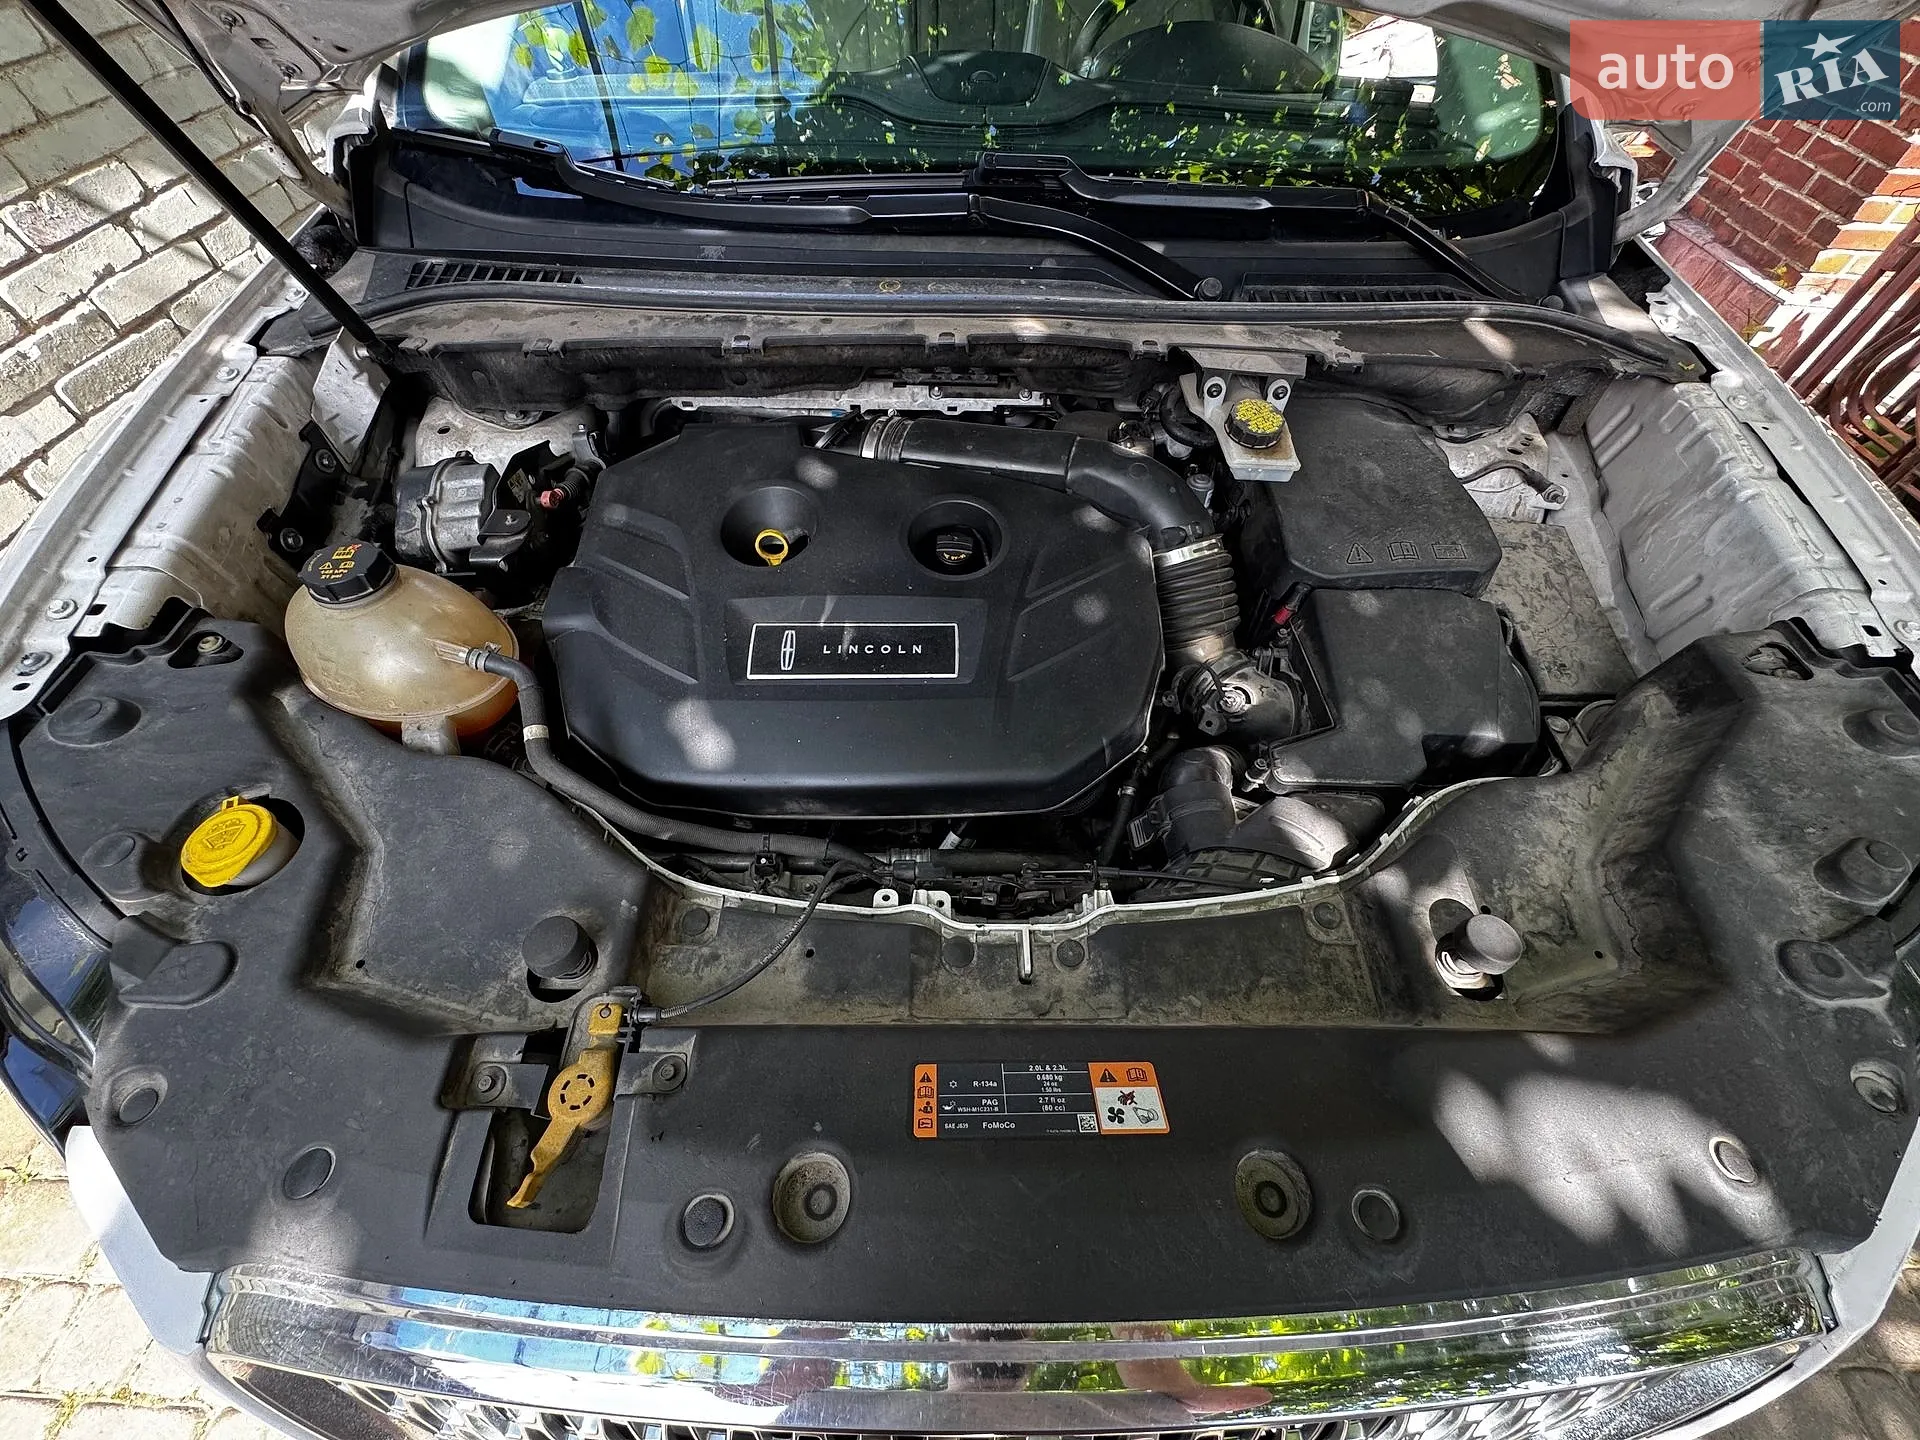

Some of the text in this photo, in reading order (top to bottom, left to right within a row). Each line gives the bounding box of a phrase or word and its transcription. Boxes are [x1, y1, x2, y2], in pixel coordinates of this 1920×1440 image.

[823, 644, 923, 655] LINCOLN
[982, 1098, 998, 1106] PAG
[982, 1121, 1016, 1129] FoMoCo
